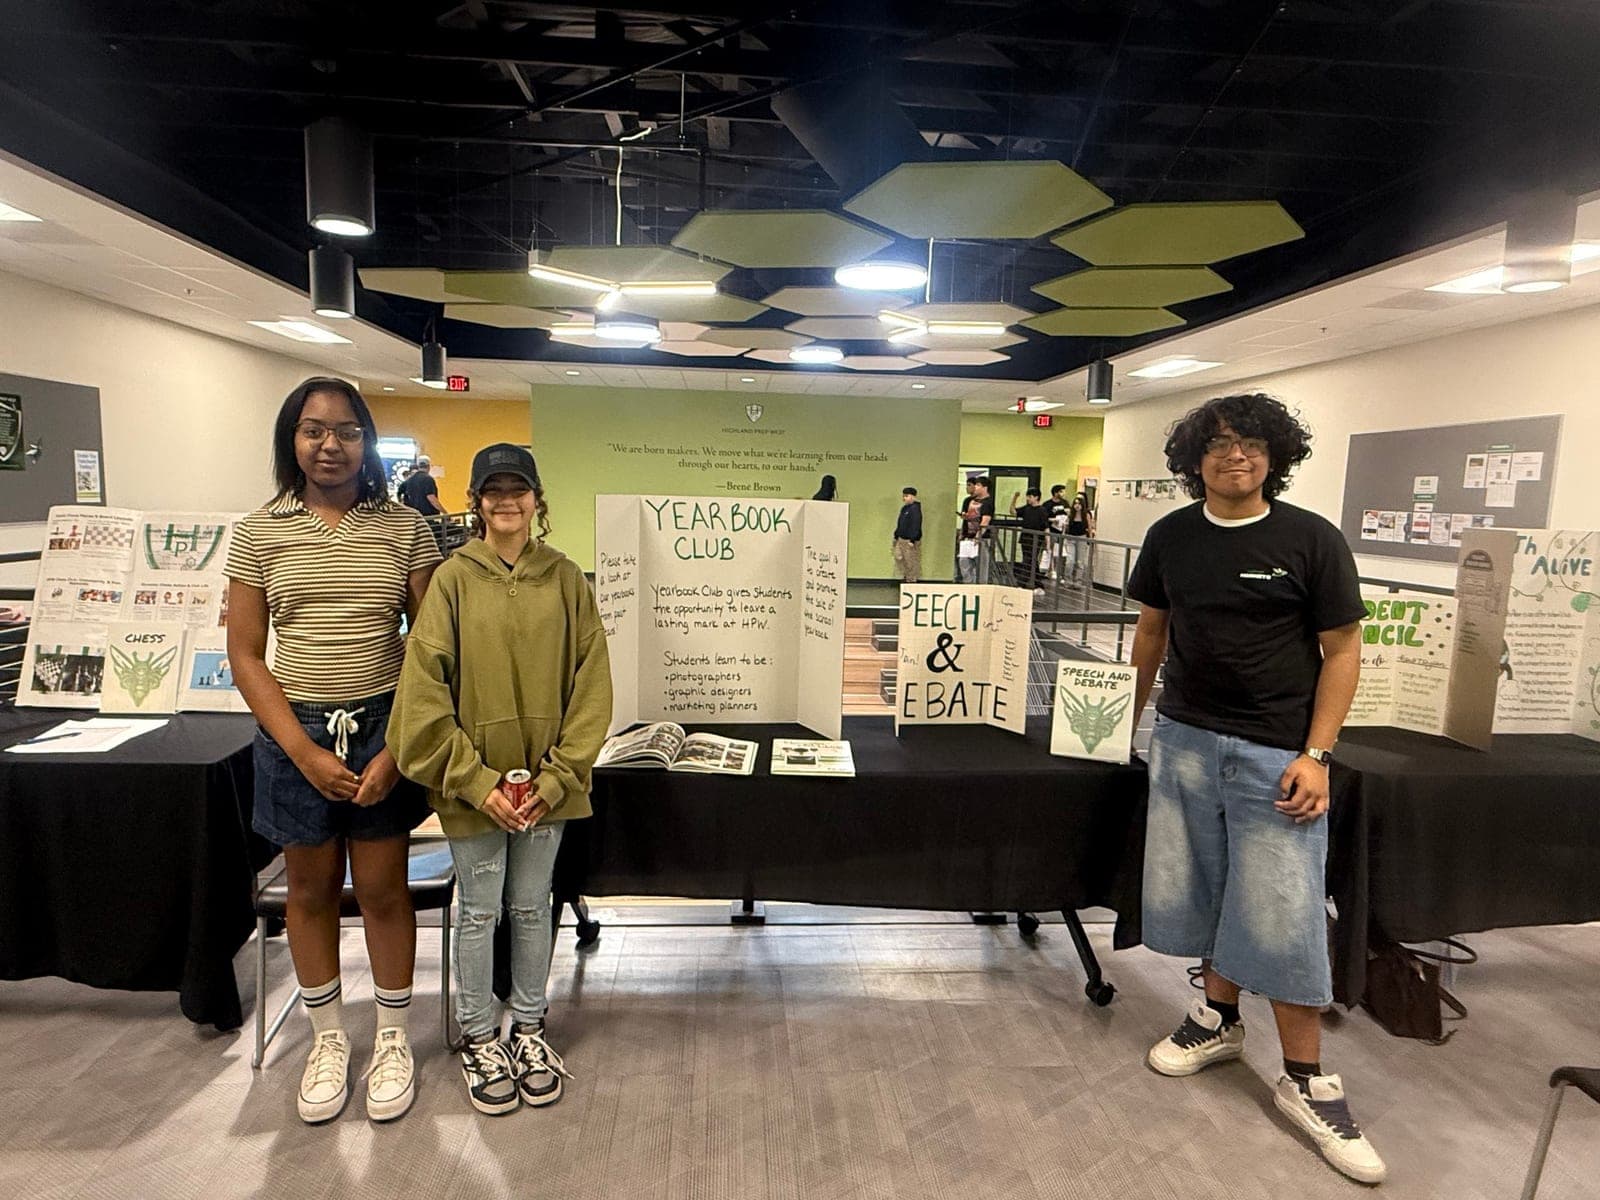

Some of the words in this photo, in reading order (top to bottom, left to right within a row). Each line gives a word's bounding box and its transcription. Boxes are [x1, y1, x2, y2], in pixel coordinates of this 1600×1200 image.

[629, 446, 643, 454] are
[644, 444, 664, 455] born
[667, 446, 700, 456] makers.
[702, 446, 717, 456] We
[744, 448, 764, 458] what
[790, 450, 822, 462] learning
[826, 451, 845, 461] from
[864, 452, 888, 462] heads
[678, 459, 712, 471] through
[732, 460, 760, 470] hearts,
[762, 463, 770, 471] to
[754, 482, 781, 492] Brown
[646, 498, 791, 533] YEARBOOK
[674, 536, 734, 560] CLUB
[650, 584, 700, 607] Yearbook
[702, 585, 722, 597] Club
[726, 589, 751, 604] gives
[653, 603, 671, 614] the
[674, 602, 722, 618] opportunity
[728, 604, 738, 612] to
[740, 600, 765, 614] leave
[768, 606, 776, 614] a
[654, 618, 689, 634] lasting
[723, 620, 736, 628] at
[125, 632, 166, 644] CHESS
[664, 650, 710, 666] Students
[715, 652, 736, 664] learn
[740, 652, 751, 664] to
[926, 632, 966, 673] &
[1063, 666, 1105, 678] SPEECH
[1108, 672, 1132, 682] AND
[1074, 678, 1118, 690] DEBATE
[711, 686, 751, 700] designers
[720, 702, 758, 713] planners
[904, 681, 1008, 722] EBATE
